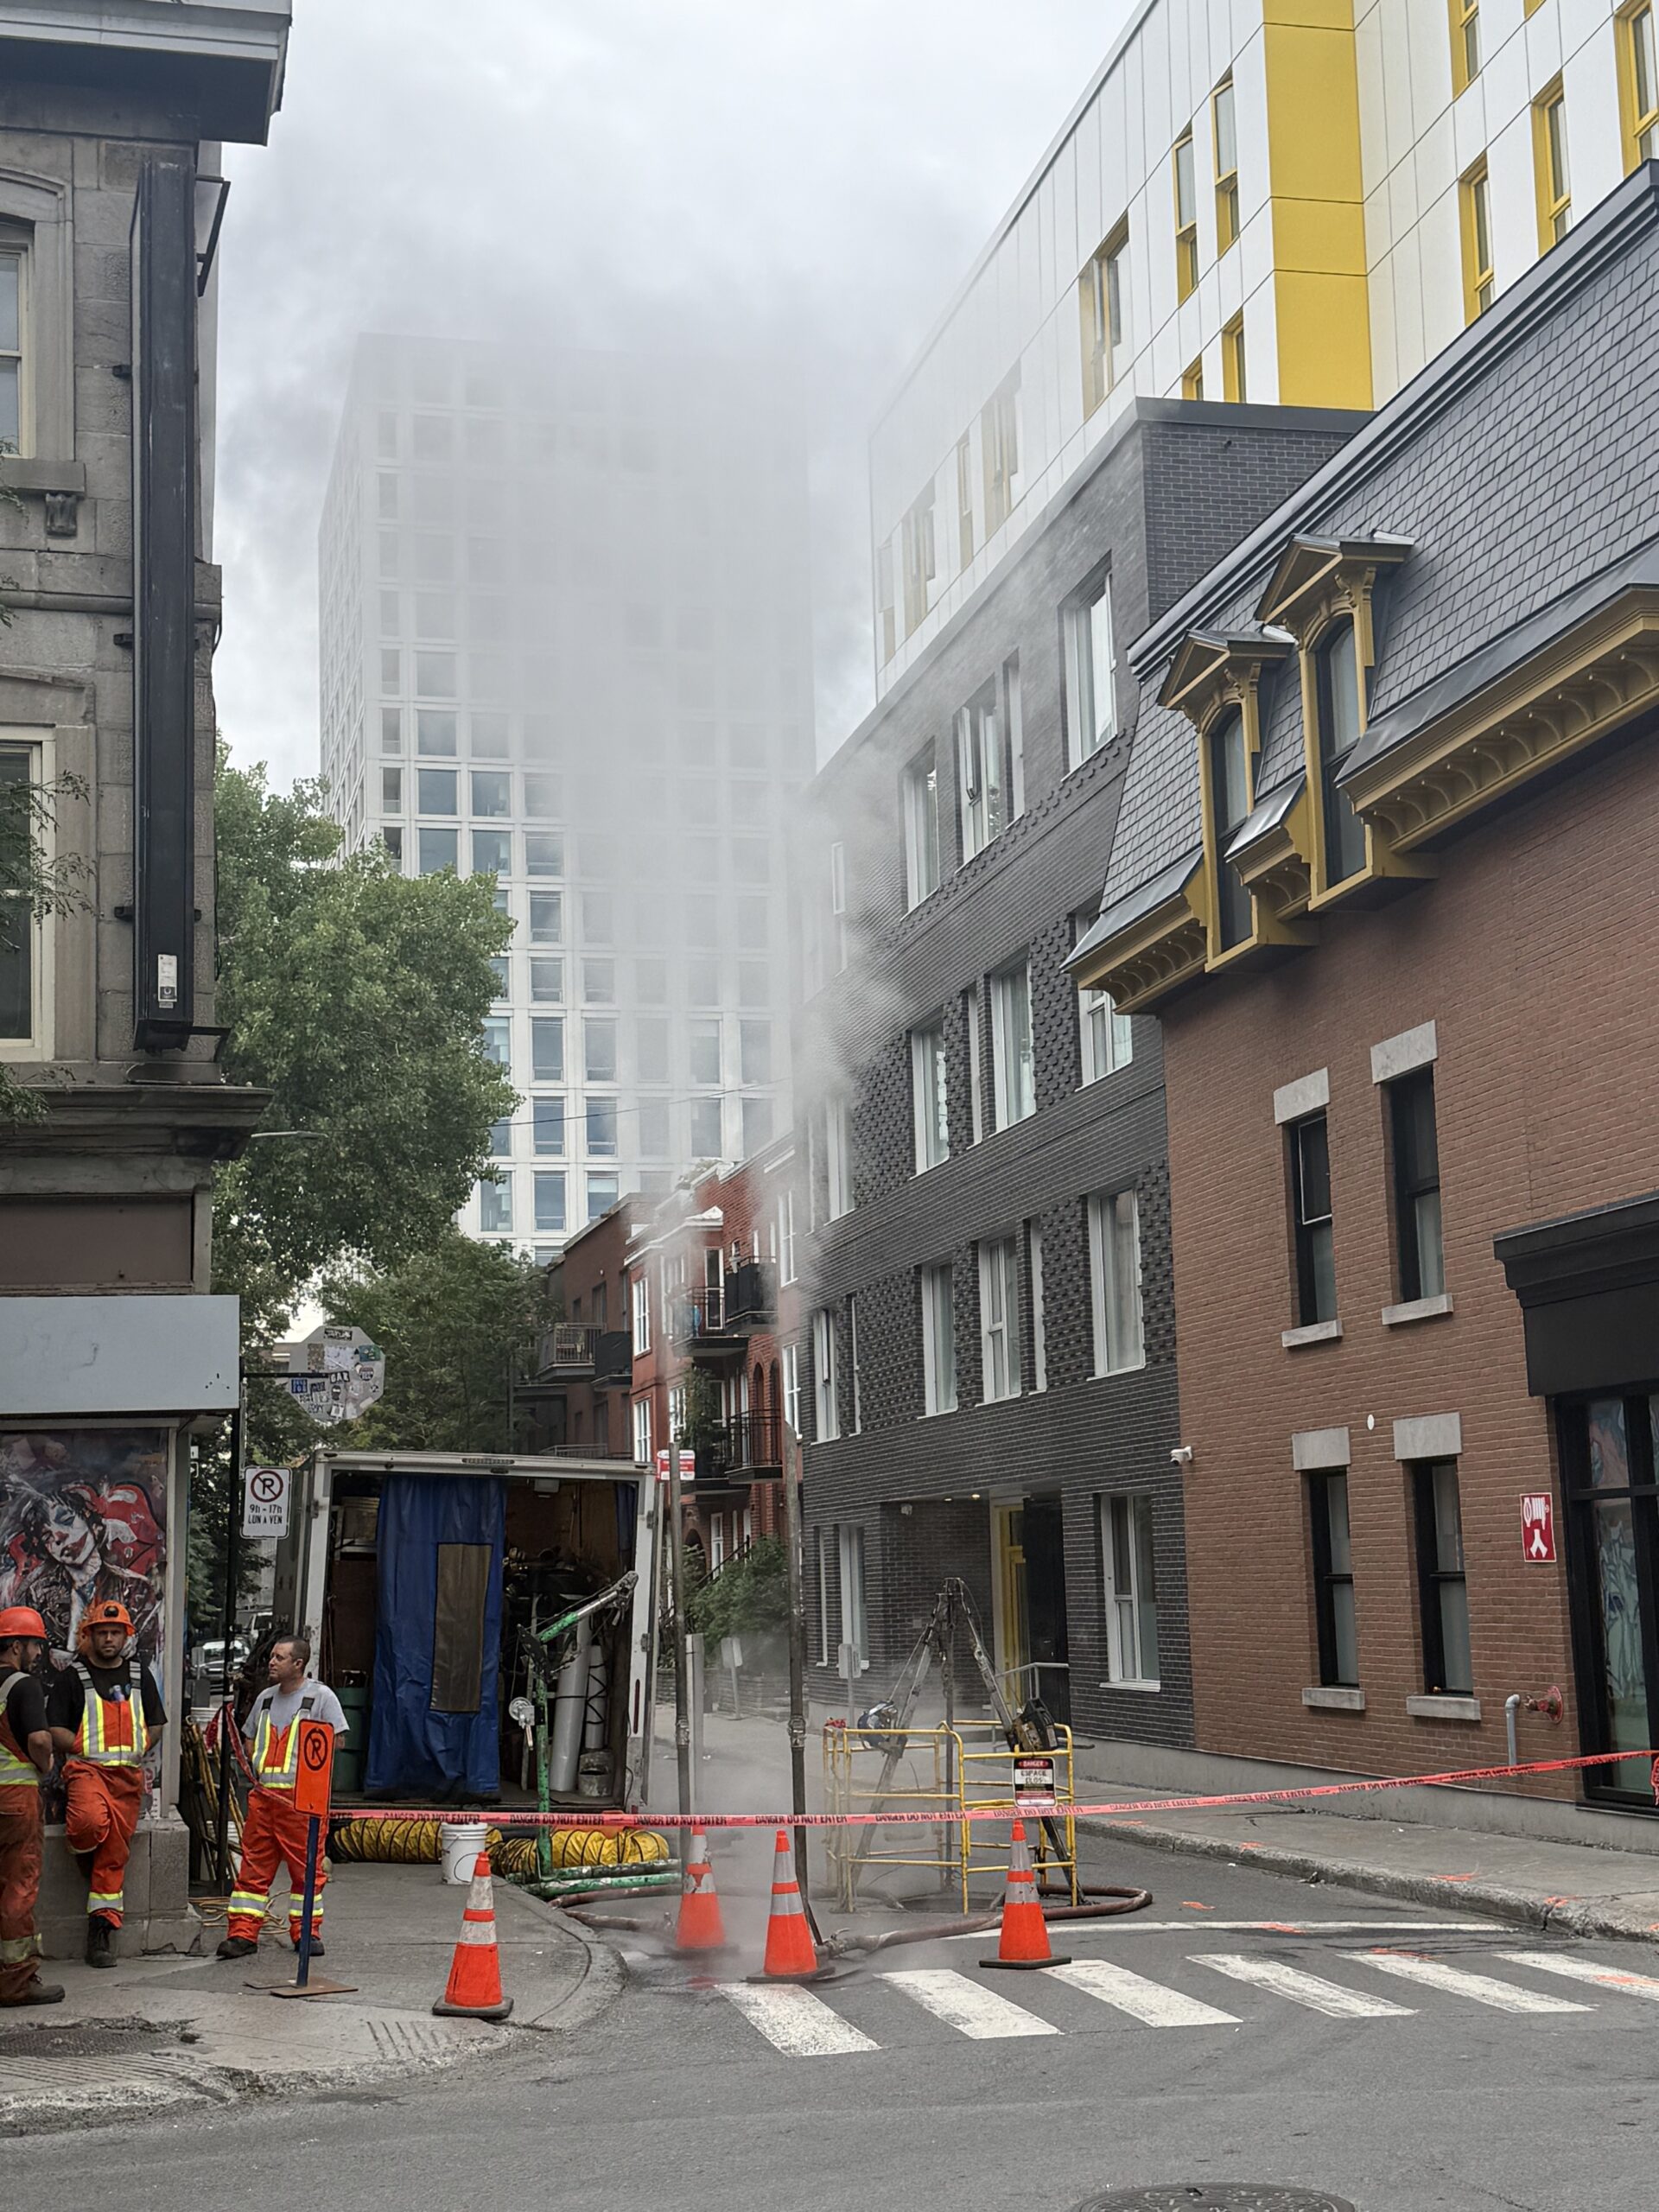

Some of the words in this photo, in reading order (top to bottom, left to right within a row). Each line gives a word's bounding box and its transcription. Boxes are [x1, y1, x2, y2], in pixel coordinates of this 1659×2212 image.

[250, 1504, 260, 1514] 9h
[270, 1504, 282, 1514] 17h
[248, 1515, 261, 1524] LUN
[270, 1516, 283, 1524] VEN
[510, 1815, 540, 1824] DANGER
[543, 1815, 555, 1825] DO
[557, 1815, 573, 1825] NOT
[576, 1815, 604, 1825] ENTER
[634, 1816, 664, 1825] DANGER
[665, 1816, 677, 1825] DO
[680, 1816, 696, 1825] NOT
[699, 1816, 727, 1825] ENTER
[755, 1815, 785, 1824] DANGER
[787, 1815, 799, 1824] DO
